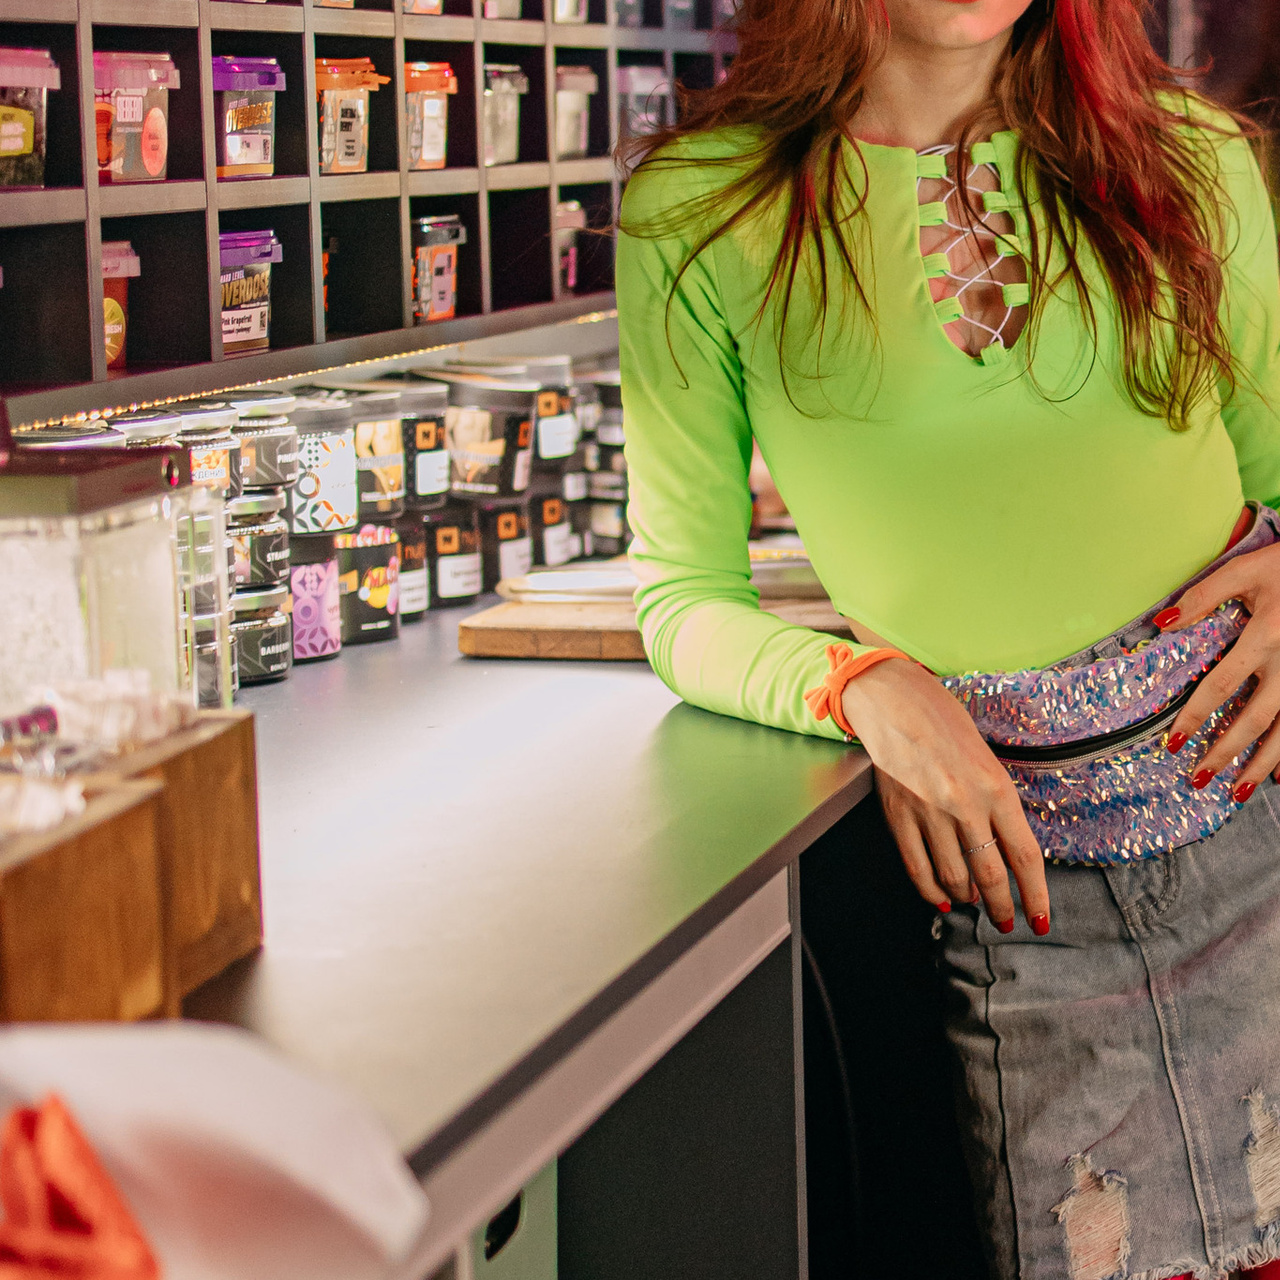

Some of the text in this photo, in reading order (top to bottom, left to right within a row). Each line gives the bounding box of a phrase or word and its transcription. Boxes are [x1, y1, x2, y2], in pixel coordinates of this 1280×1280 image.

[116, 96, 144, 122] SEBERO
[225, 101, 273, 133] OVERDOSE
[232, 268, 245, 281] LEVEL
